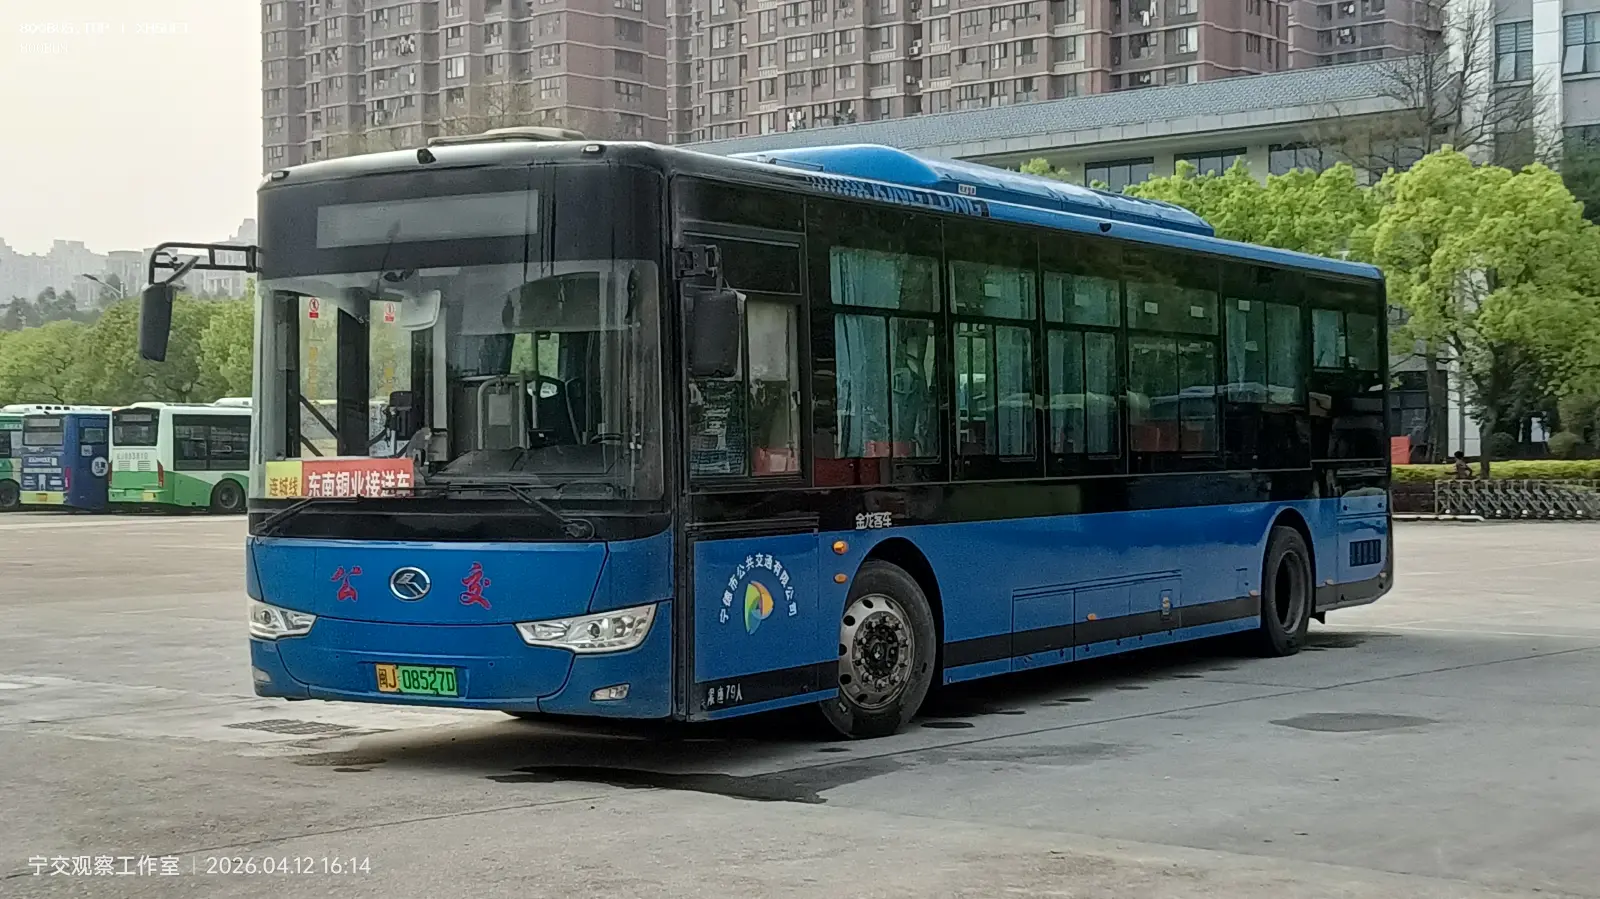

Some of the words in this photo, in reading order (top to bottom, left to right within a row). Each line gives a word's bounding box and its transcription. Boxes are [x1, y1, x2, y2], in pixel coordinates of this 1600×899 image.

[308, 470, 411, 497] 东南铜业接送车
[855, 511, 893, 530] 金龙客车
[719, 552, 798, 625] 宁德市公共交通有限公司
